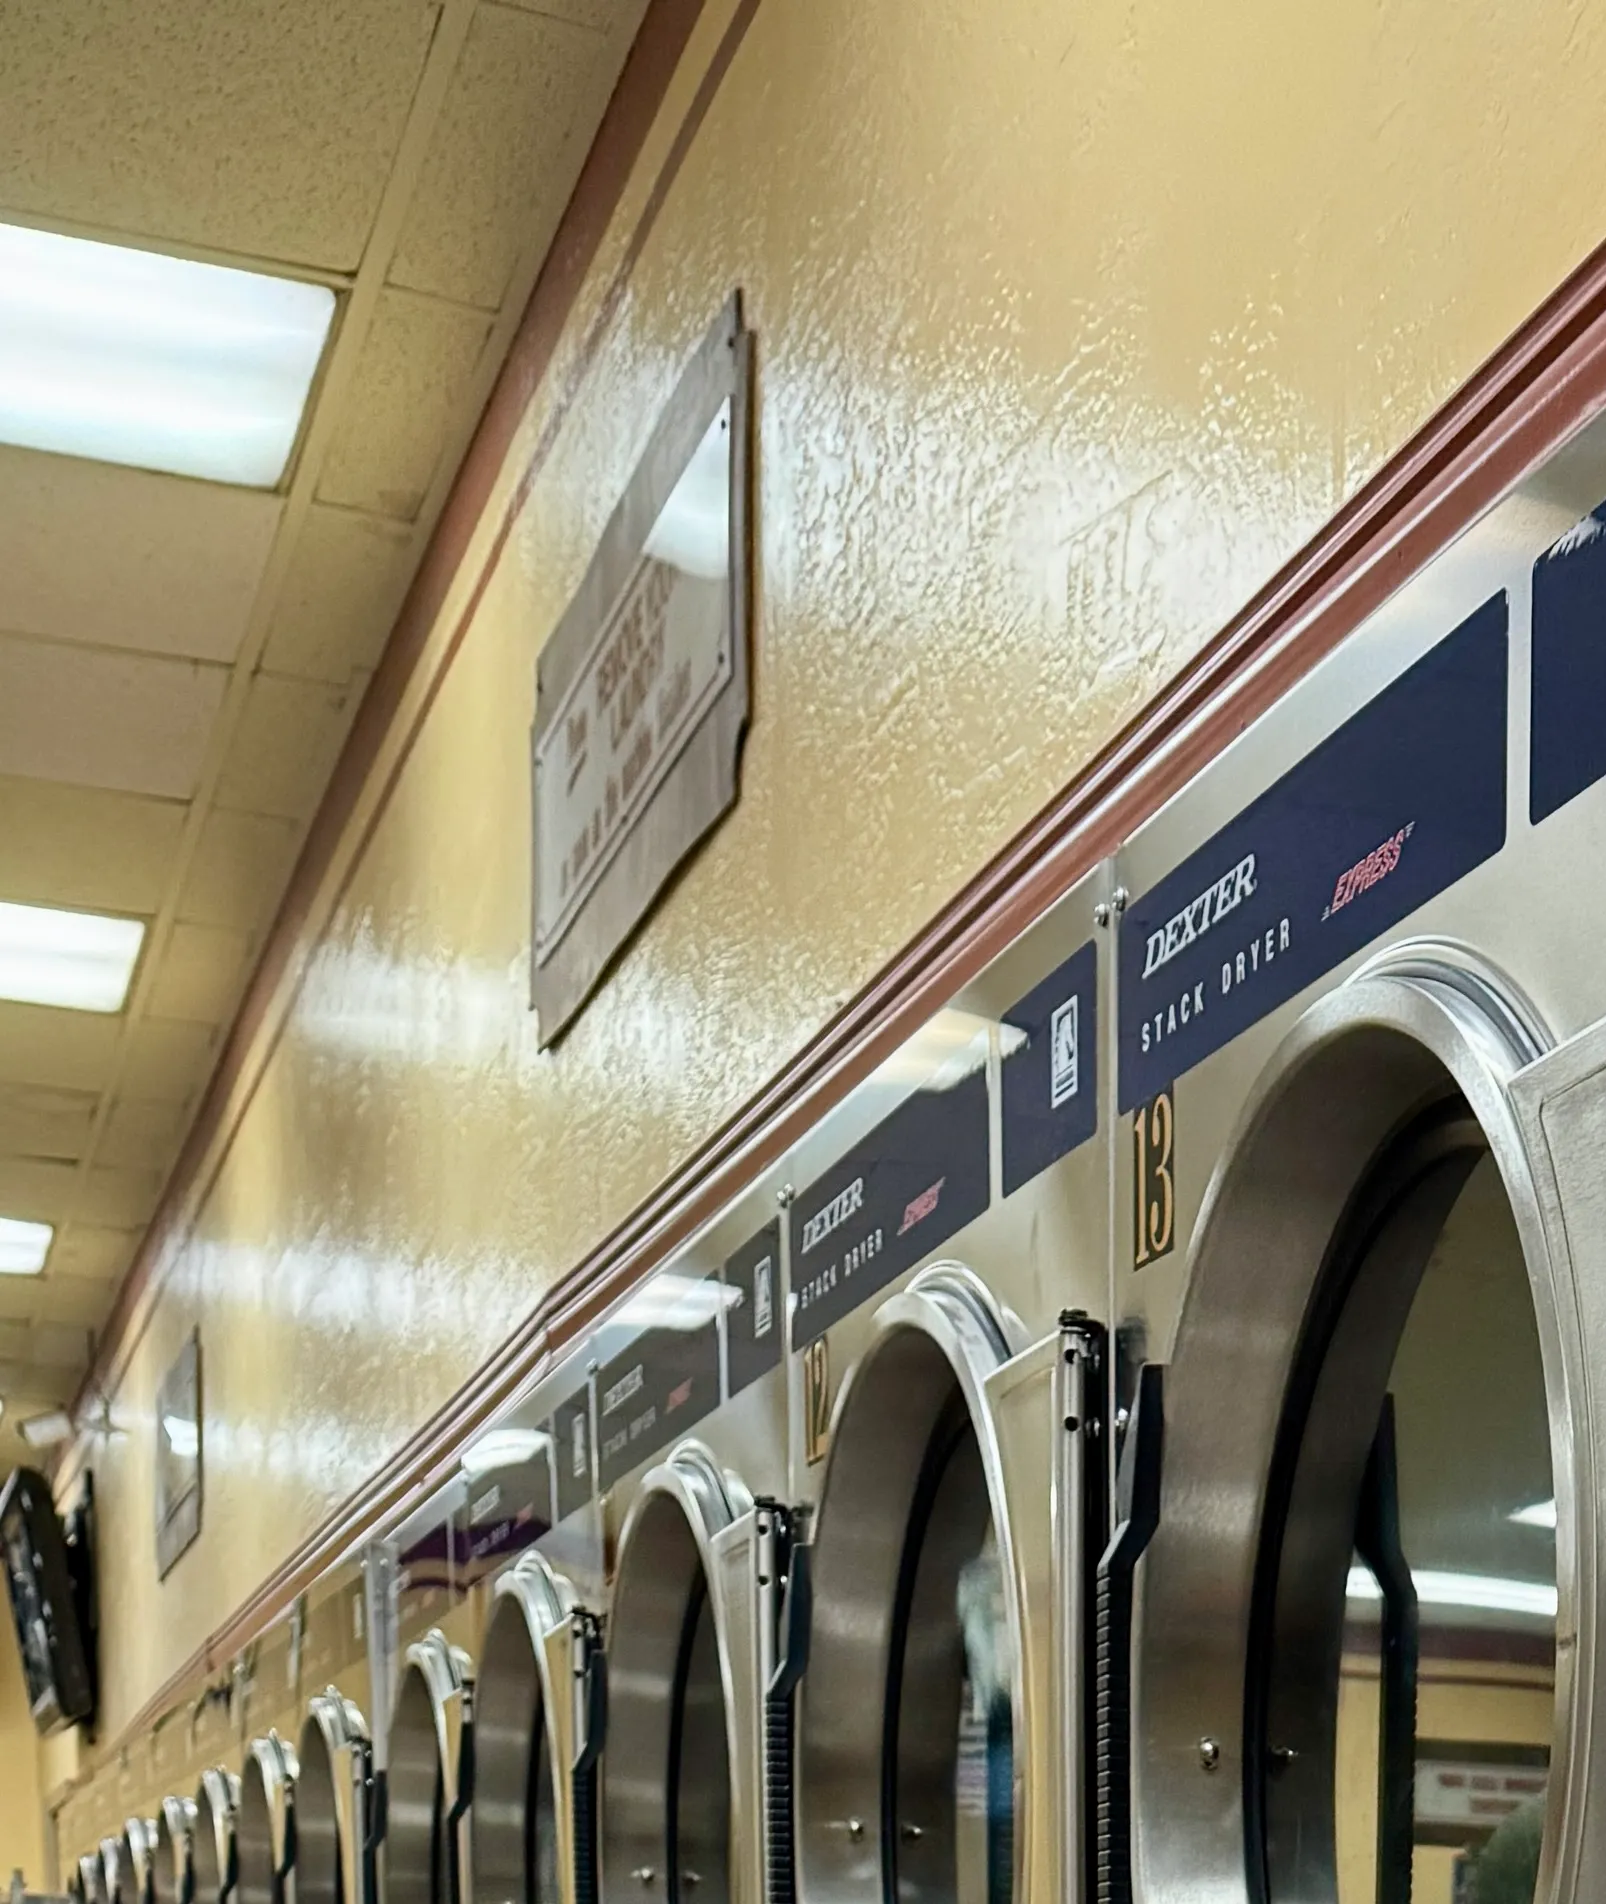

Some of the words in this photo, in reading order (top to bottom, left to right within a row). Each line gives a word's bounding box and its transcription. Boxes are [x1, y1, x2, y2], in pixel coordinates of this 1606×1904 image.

[1141, 853, 1255, 980] DEXTER
[1141, 981, 1204, 1052] STACK
[1222, 918, 1290, 994] DRYER
[1134, 1093, 1173, 1264] 13
